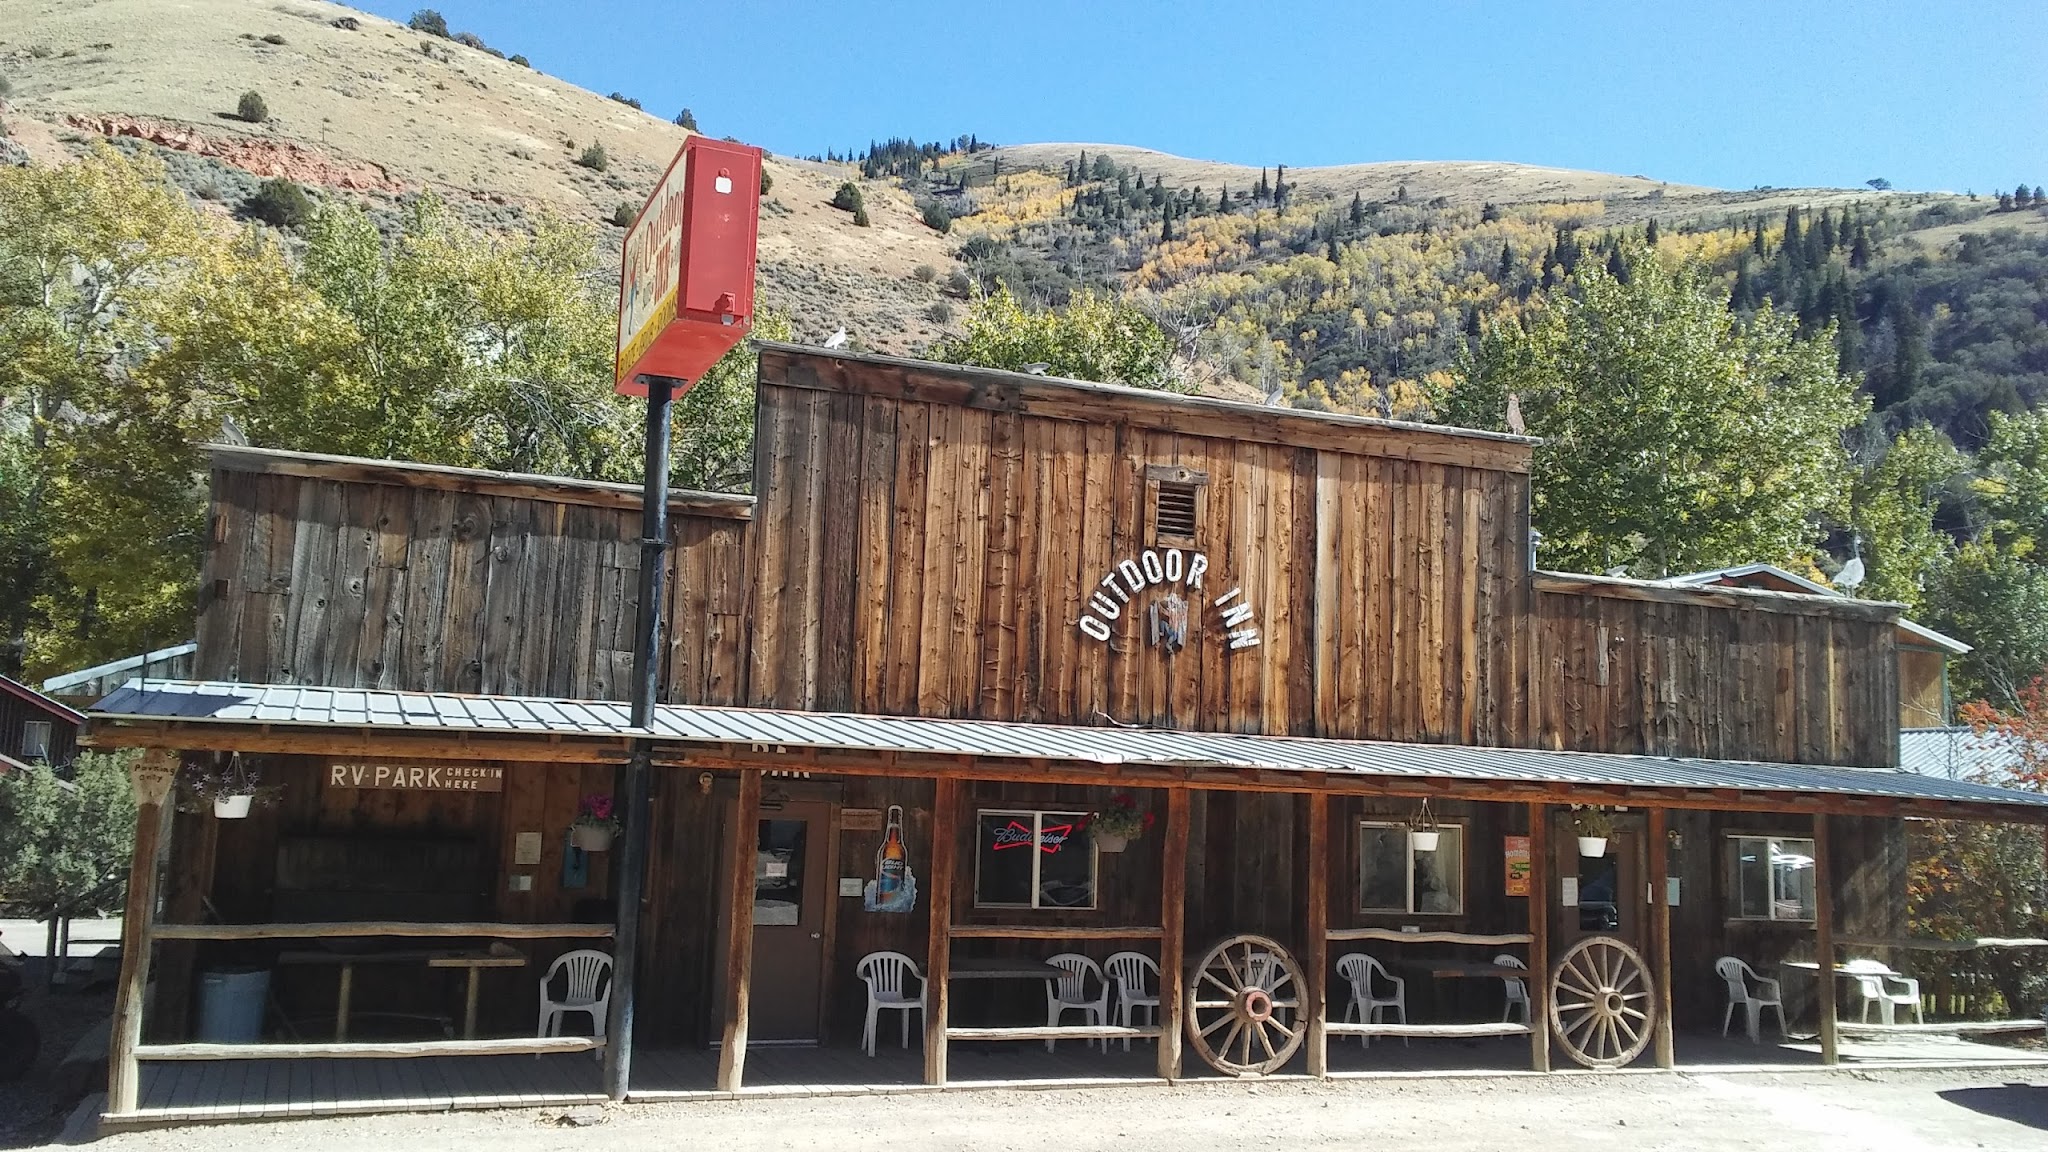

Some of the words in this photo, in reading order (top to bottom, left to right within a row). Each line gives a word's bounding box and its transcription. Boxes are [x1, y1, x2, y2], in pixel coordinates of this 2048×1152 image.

[644, 182, 683, 274] Outdoor
[1079, 548, 1208, 642] OUTDOOR
[1214, 586, 1261, 650] INN
[444, 779, 478, 790] HERE
[994, 827, 1068, 844] Budeiser
